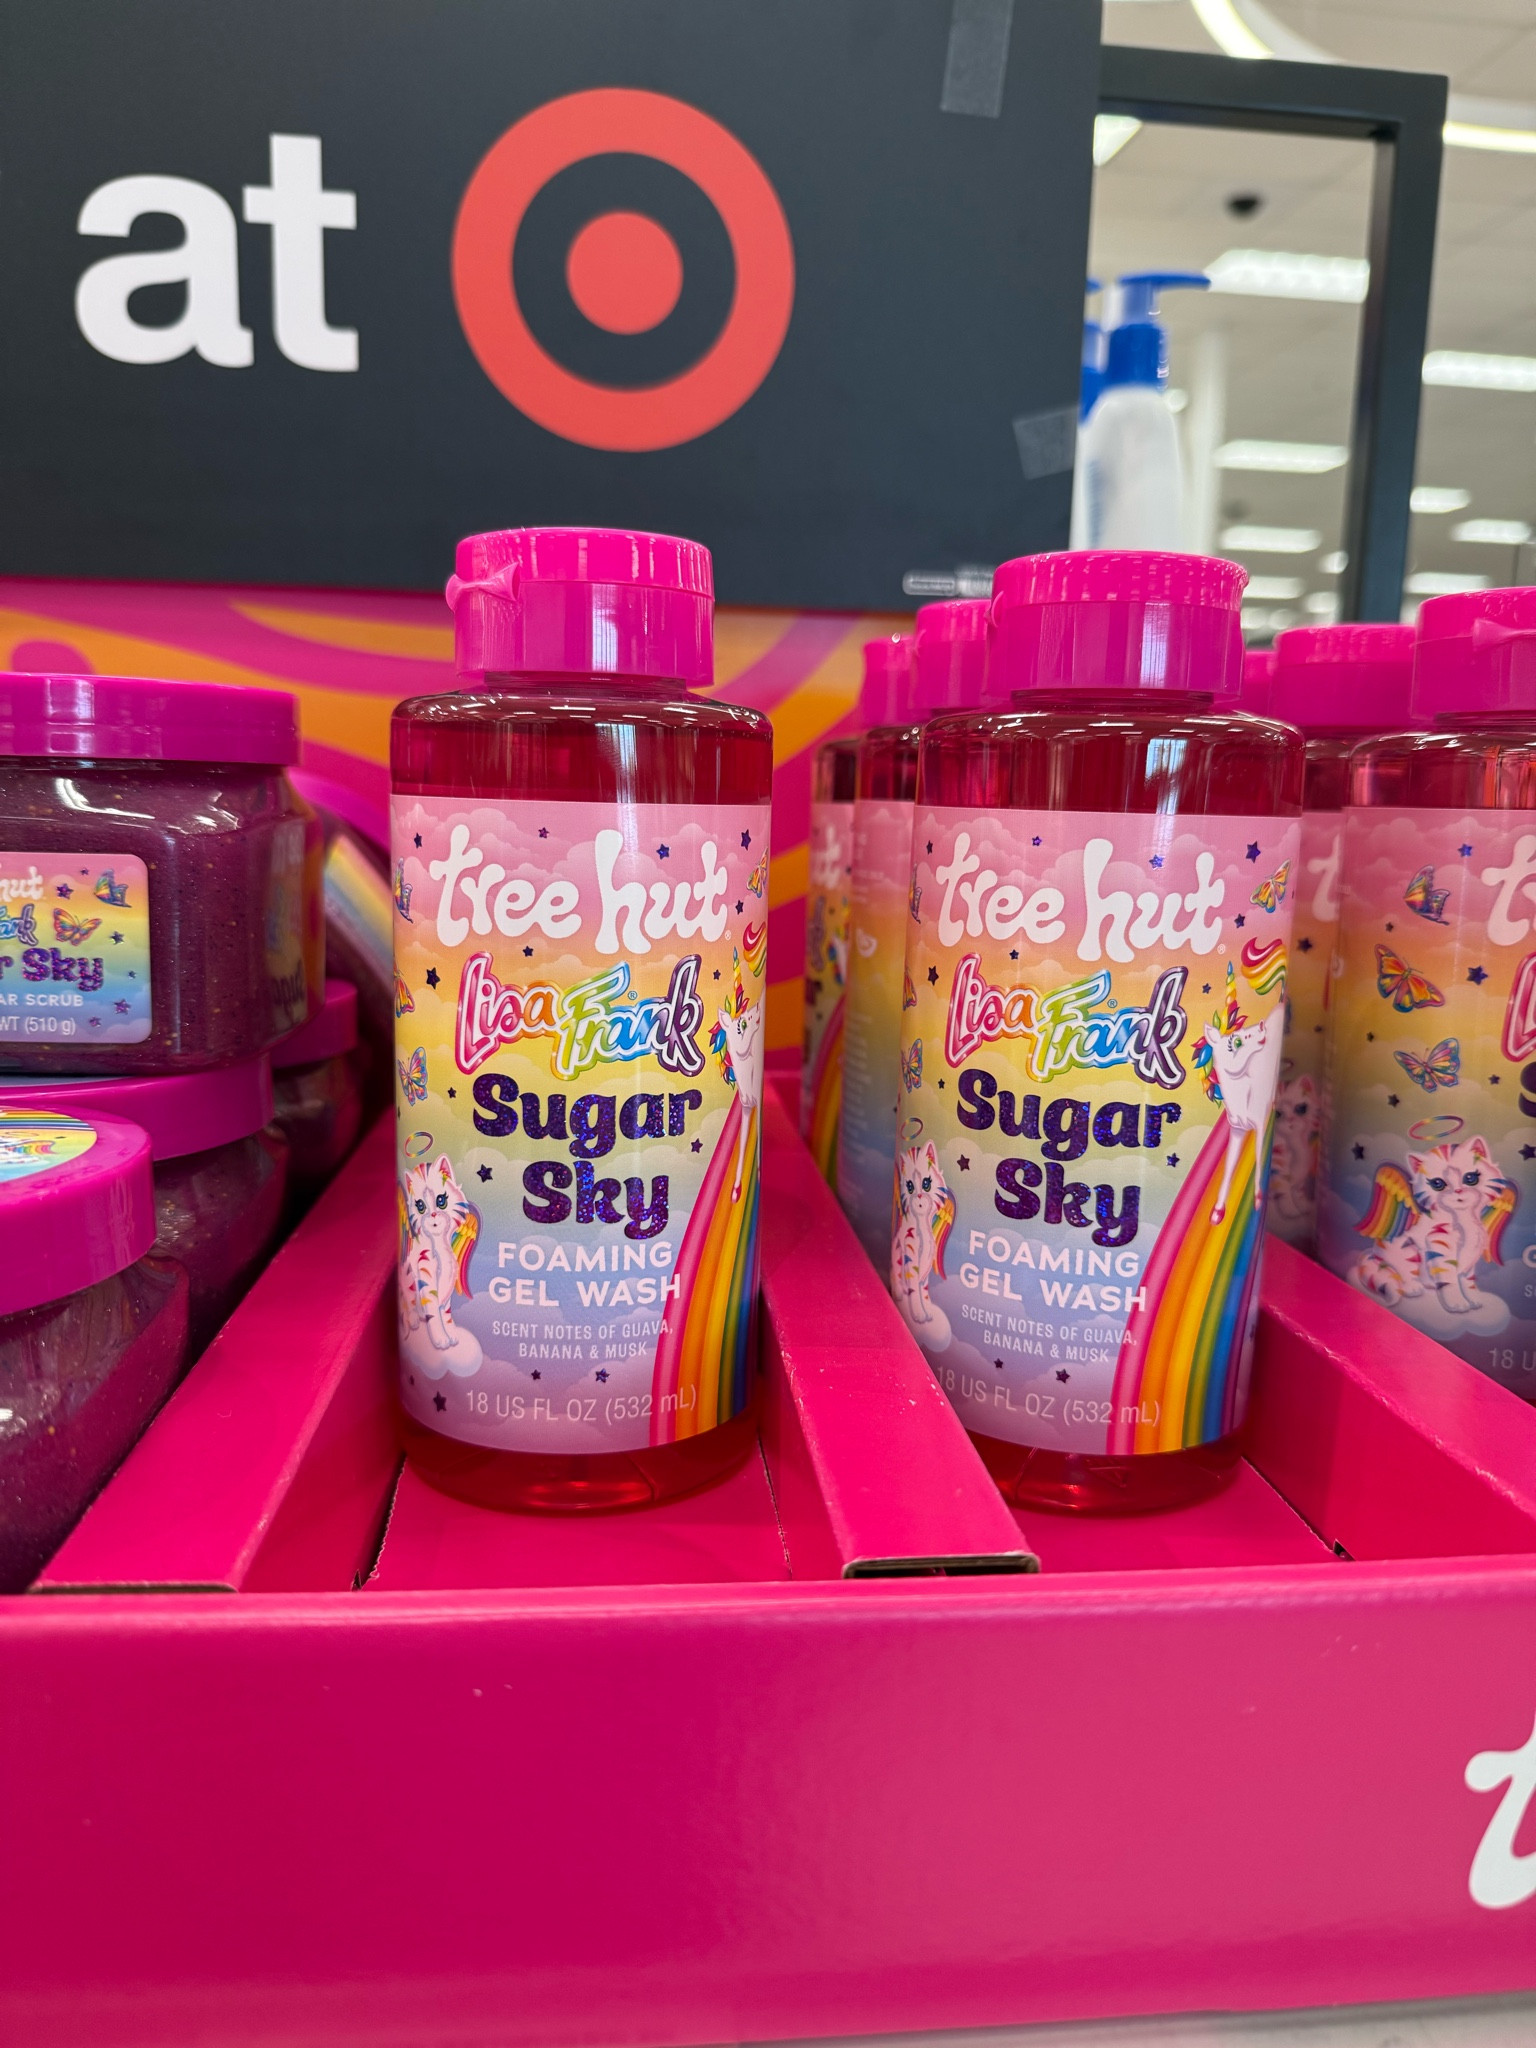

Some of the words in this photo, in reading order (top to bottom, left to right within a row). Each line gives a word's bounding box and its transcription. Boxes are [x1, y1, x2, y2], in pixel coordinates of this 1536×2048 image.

[75, 132, 360, 373] at
[429, 824, 582, 947] tree
[594, 829, 728, 954] hut
[936, 832, 1066, 947] tree
[1077, 838, 1226, 963] hut
[22, 947, 104, 992] Sky
[25, 993, 84, 1007] SCRUB
[455, 951, 564, 1075] Lisa
[551, 954, 706, 1081] Frank
[945, 952, 1041, 1068] Lisa
[1026, 966, 1189, 1089] Frank
[25, 1016, 57, 1034] (510
[62, 1017, 76, 1035] g)
[472, 1073, 703, 1158] Sugar
[957, 1069, 1182, 1160] Sugar
[522, 1160, 670, 1240] Sky
[994, 1157, 1141, 1247] Sky
[498, 1241, 673, 1272] FOAMING
[968, 1229, 1140, 1278] FOAMING
[488, 1276, 560, 1307] GEL
[576, 1273, 681, 1307] WASH
[959, 1262, 1023, 1301] GEL
[1039, 1278, 1147, 1313] WASH
[492, 1320, 539, 1339] SCENT
[544, 1324, 593, 1340] NOTES
[598, 1325, 617, 1340] OF
[622, 1319, 674, 1338] GUAVA,
[961, 1304, 1002, 1328] SCENT
[1007, 1317, 1054, 1338] NOTES
[1060, 1326, 1078, 1340] OF
[1083, 1328, 1138, 1346] GUAVA,
[983, 1329, 1044, 1356] BANANA
[1050, 1344, 1060, 1358] &
[1066, 1344, 1109, 1362] MUSK
[519, 1342, 584, 1359] BANANA
[589, 1344, 599, 1359] &
[605, 1341, 648, 1358] MUSK
[1488, 1347, 1514, 1369] 18
[466, 1389, 489, 1414] 18
[496, 1394, 525, 1419] US
[533, 1399, 559, 1421] FL
[566, 1398, 597, 1423] OZ
[605, 1394, 653, 1425] (532
[660, 1383, 697, 1414] mL)
[937, 1365, 955, 1391] 18
[961, 1373, 987, 1402] US
[994, 1385, 1017, 1412] FL
[1025, 1393, 1056, 1418] OZ
[1063, 1397, 1112, 1426] (532
[1120, 1399, 1161, 1427] mL)
